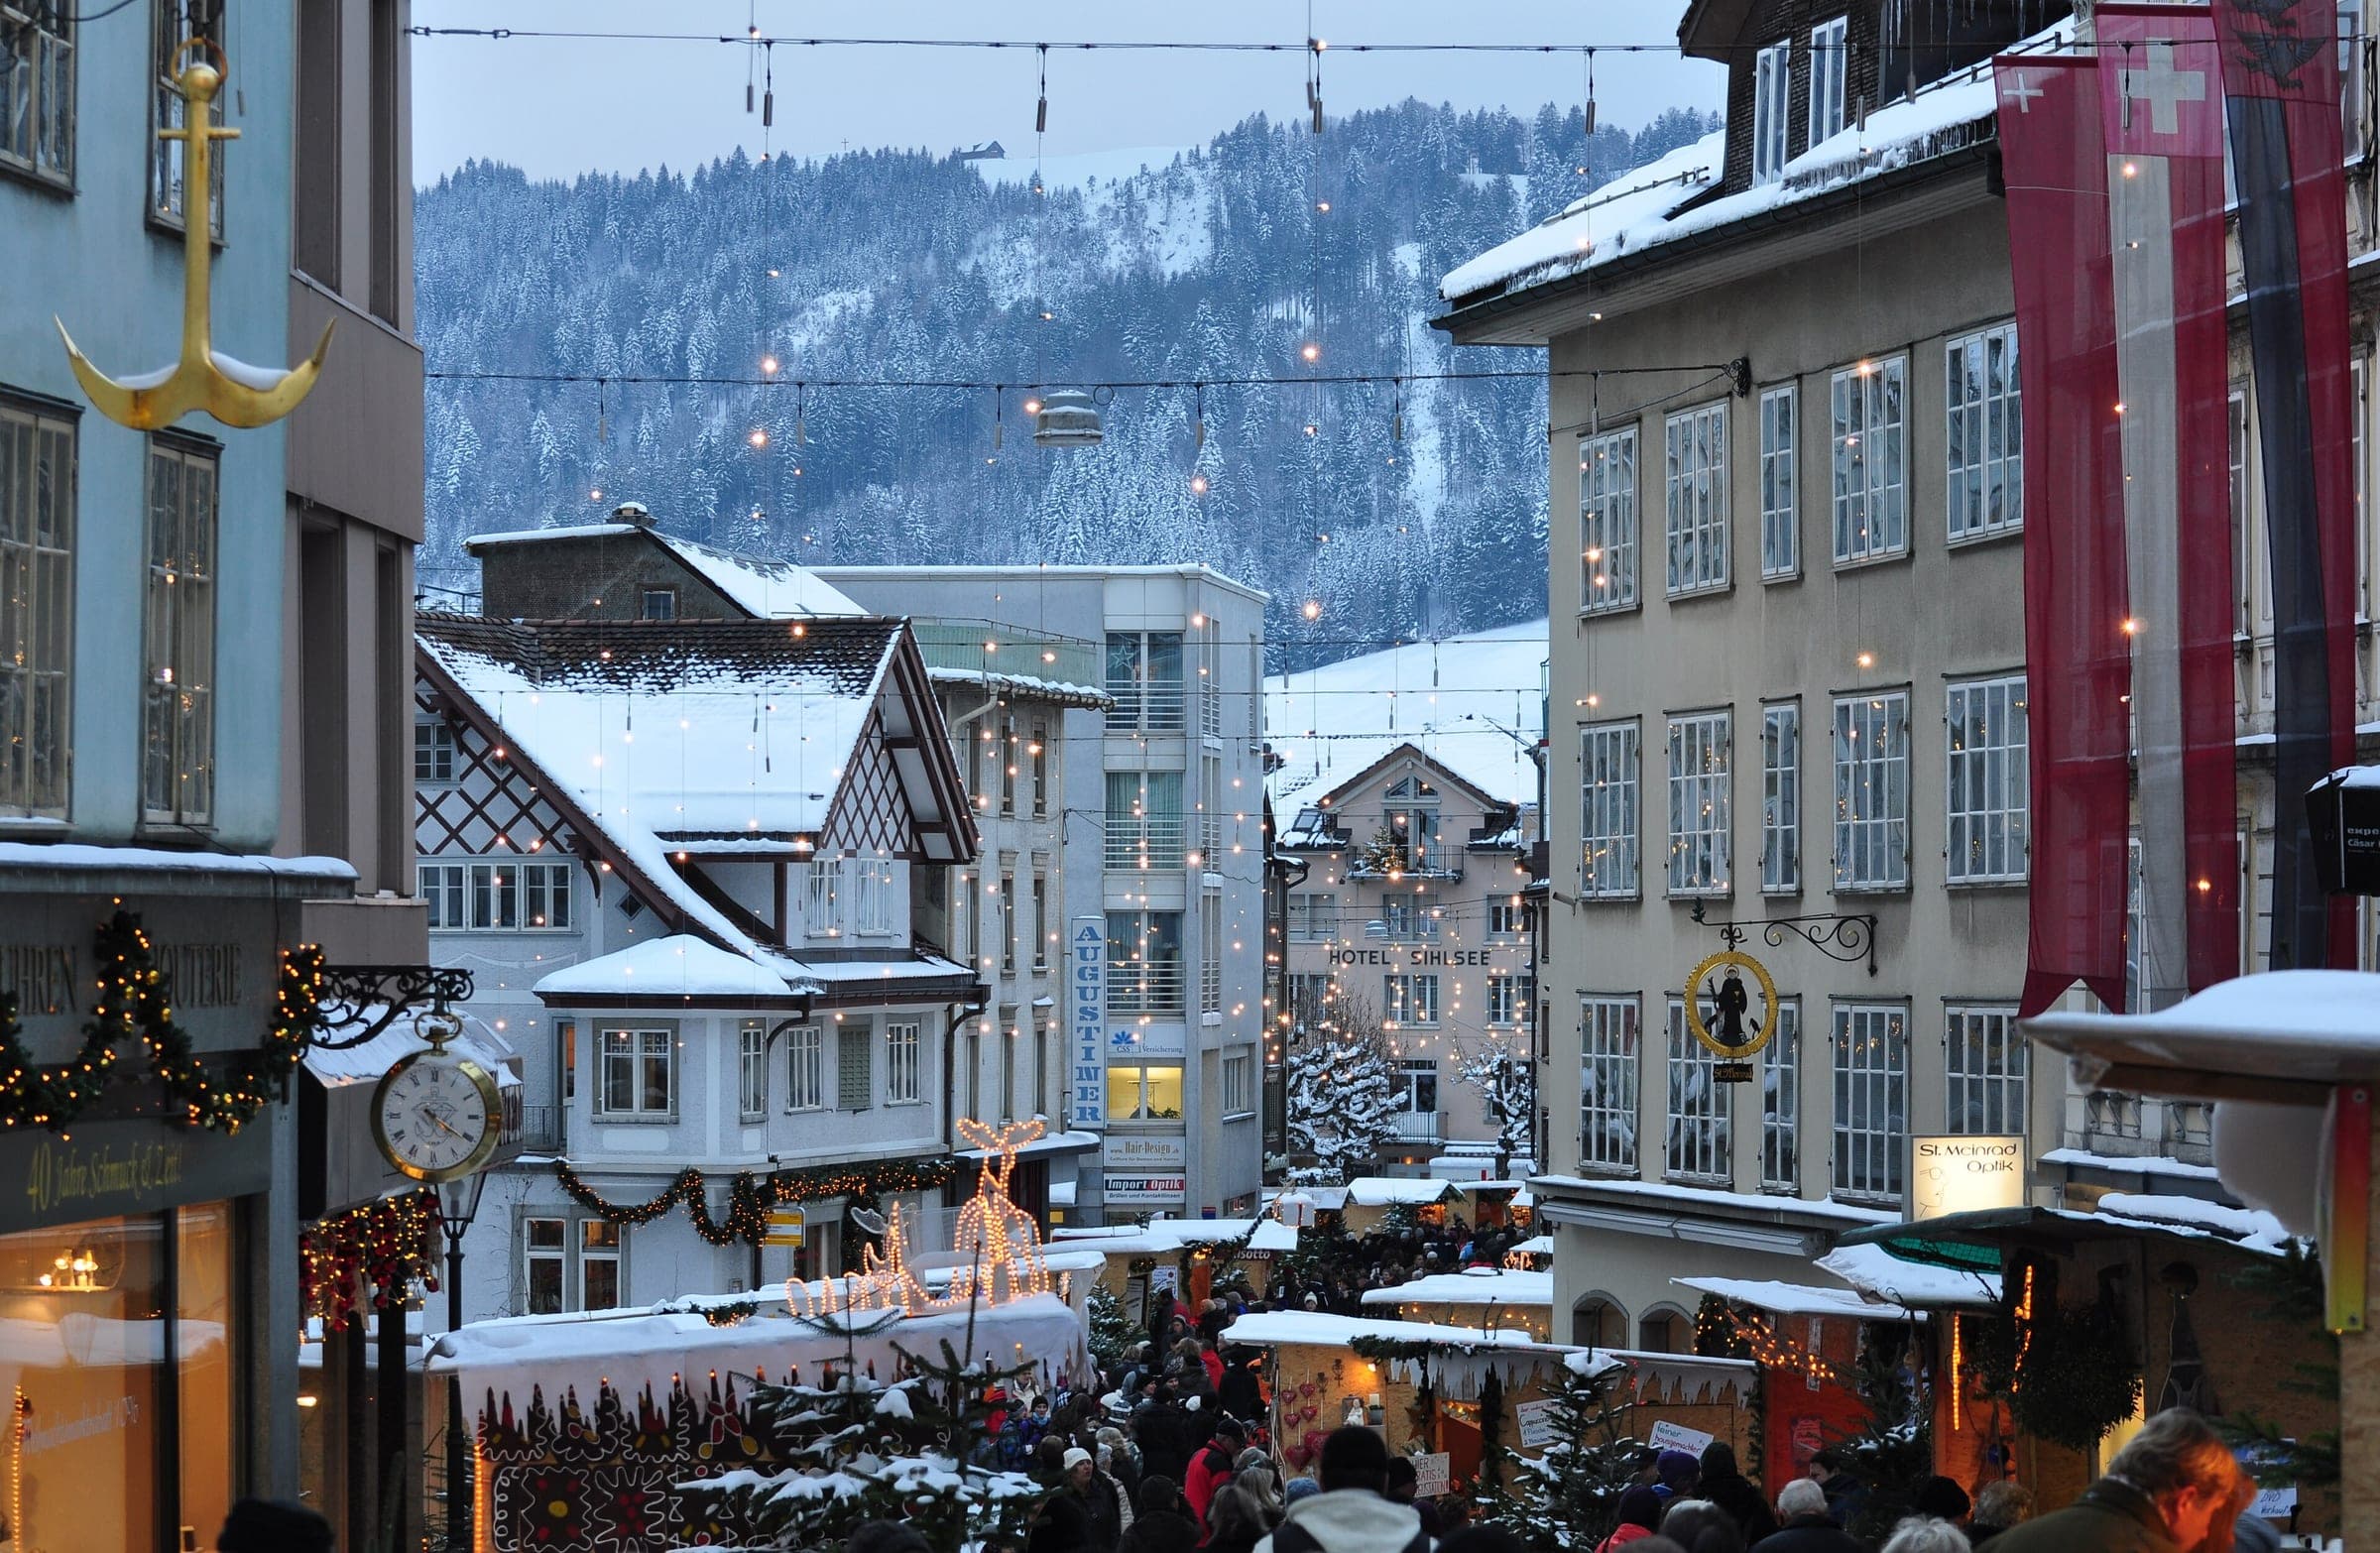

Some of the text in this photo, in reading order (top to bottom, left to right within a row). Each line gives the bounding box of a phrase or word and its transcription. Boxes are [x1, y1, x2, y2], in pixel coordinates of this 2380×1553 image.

[1329, 950, 1491, 966] HOTEL SIHLSEE
[1075, 926, 1102, 1121] AUGUSTINER
[1920, 1143, 2017, 1156] St. Meinrad
[1967, 1160, 2013, 1173] Optik
[26, 1141, 52, 1214] 40
[1109, 1179, 1180, 1190] Import Optik
[1234, 1250, 1270, 1259] isotto
